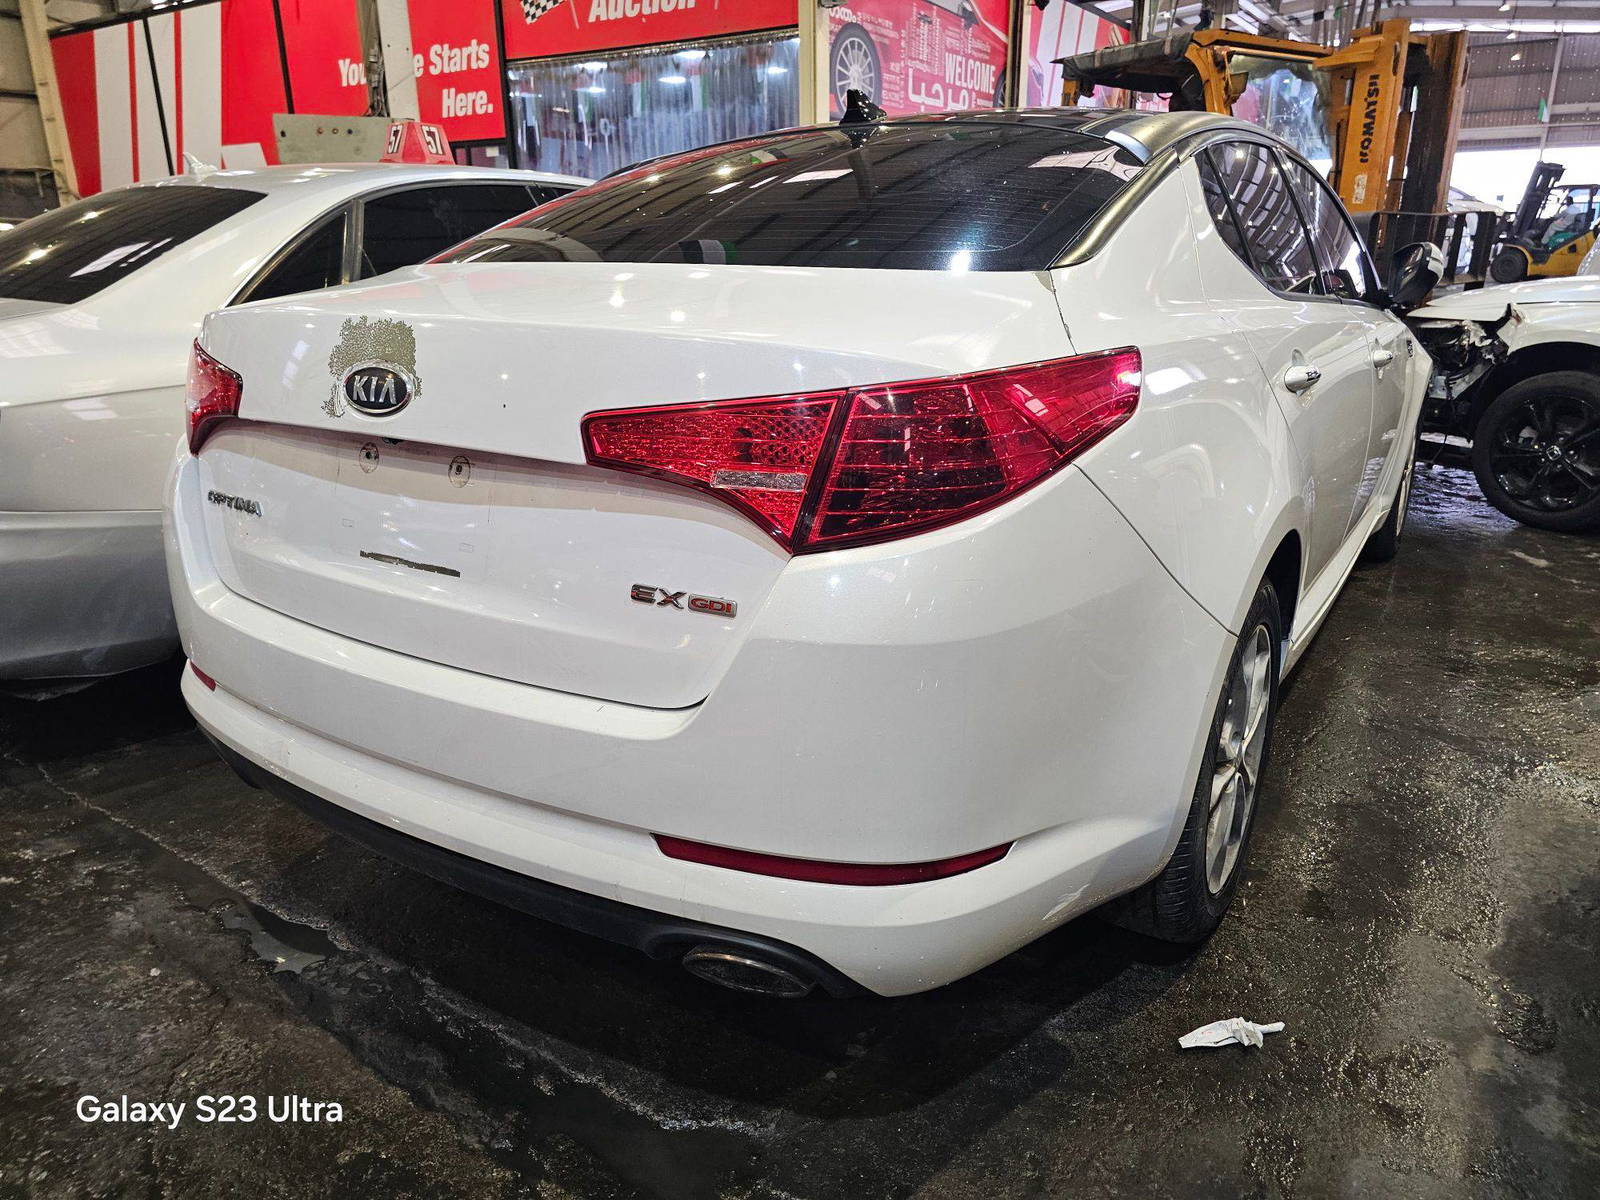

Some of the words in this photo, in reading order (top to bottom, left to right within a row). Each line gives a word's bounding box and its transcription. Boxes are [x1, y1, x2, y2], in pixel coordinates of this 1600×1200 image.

[429, 39, 490, 75] Starts
[945, 52, 997, 95] WELCOME
[442, 87, 494, 118] Here.
[388, 125, 403, 154] 57
[421, 125, 444, 155] 57
[352, 375, 397, 404] KIA
[630, 584, 687, 610] EX
[690, 595, 735, 616] GDI
